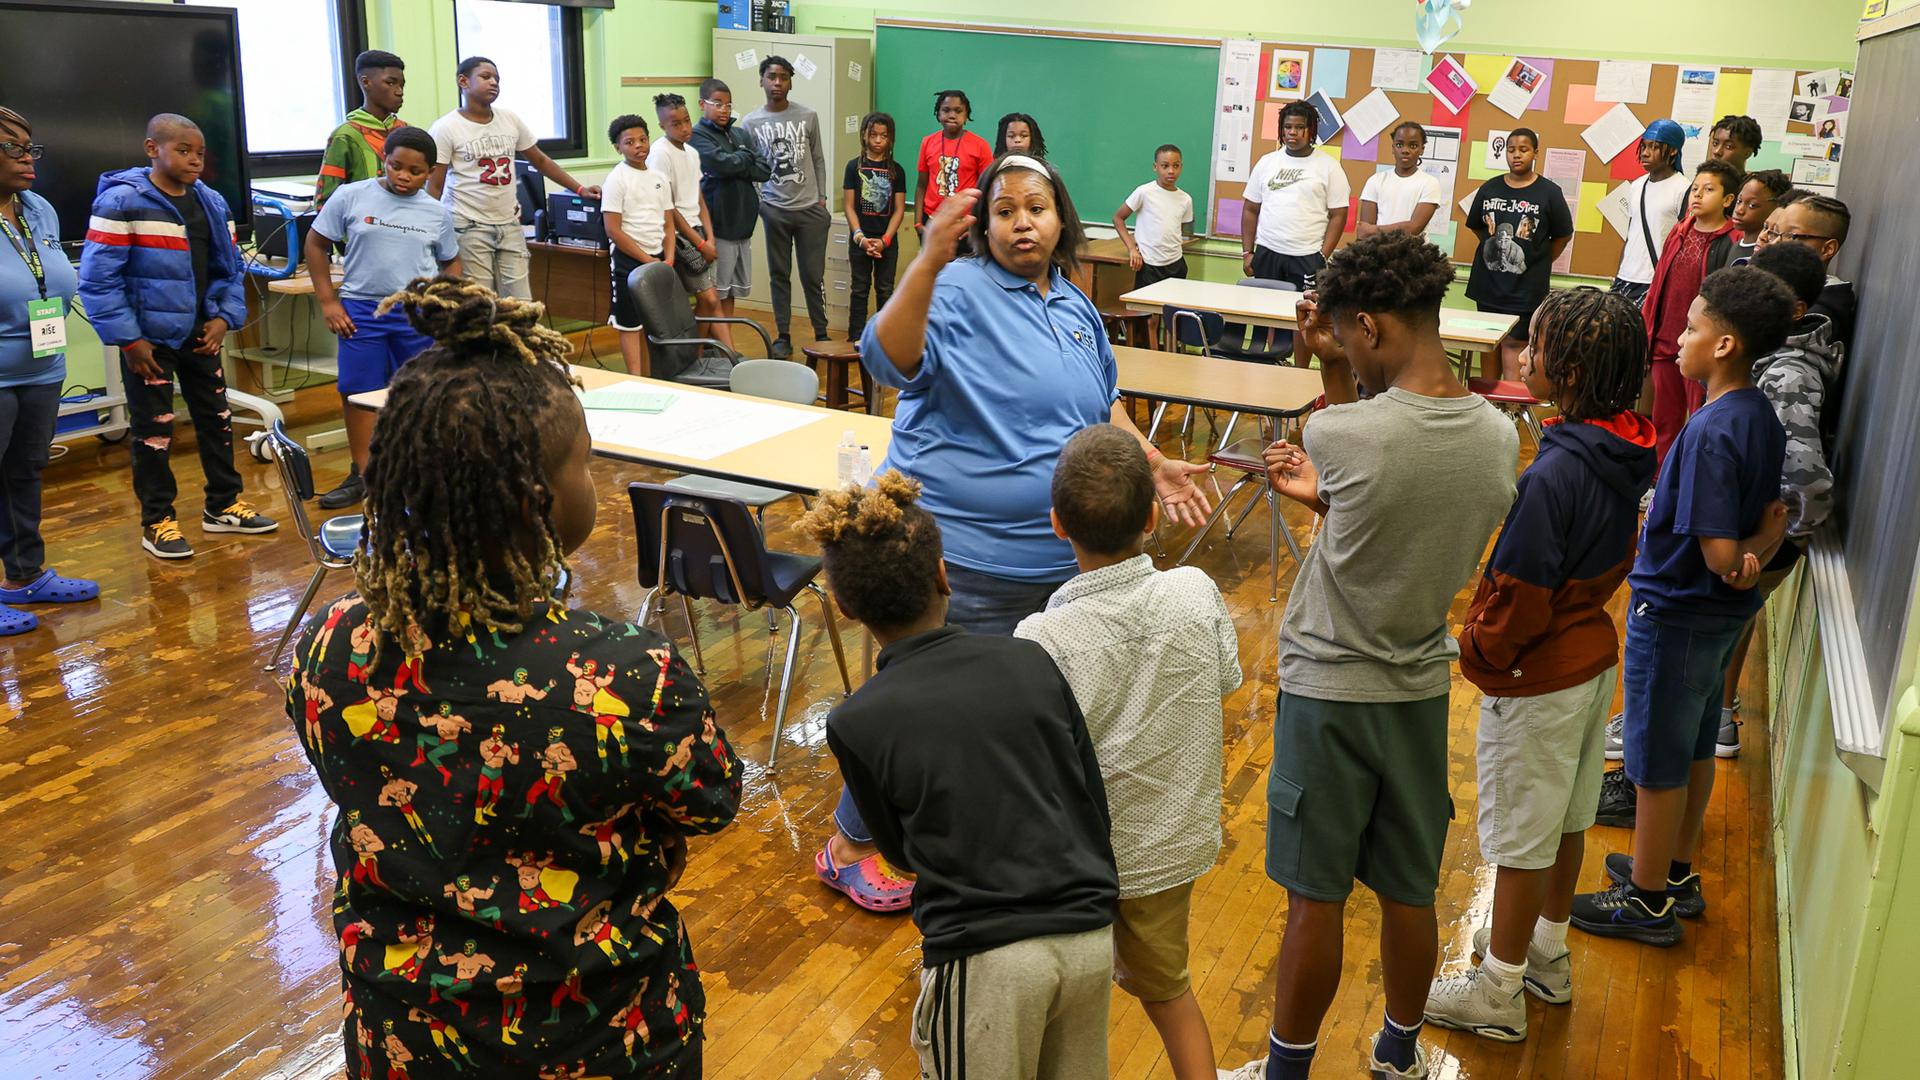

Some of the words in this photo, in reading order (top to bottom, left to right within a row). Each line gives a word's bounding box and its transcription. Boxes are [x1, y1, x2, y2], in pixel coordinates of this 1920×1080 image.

[754, 121, 775, 148] NO
[464, 135, 515, 162] JORDAN
[478, 156, 512, 186] 23
[1275, 168, 1304, 180] NIKE
[41, 325, 56, 336] RISE
